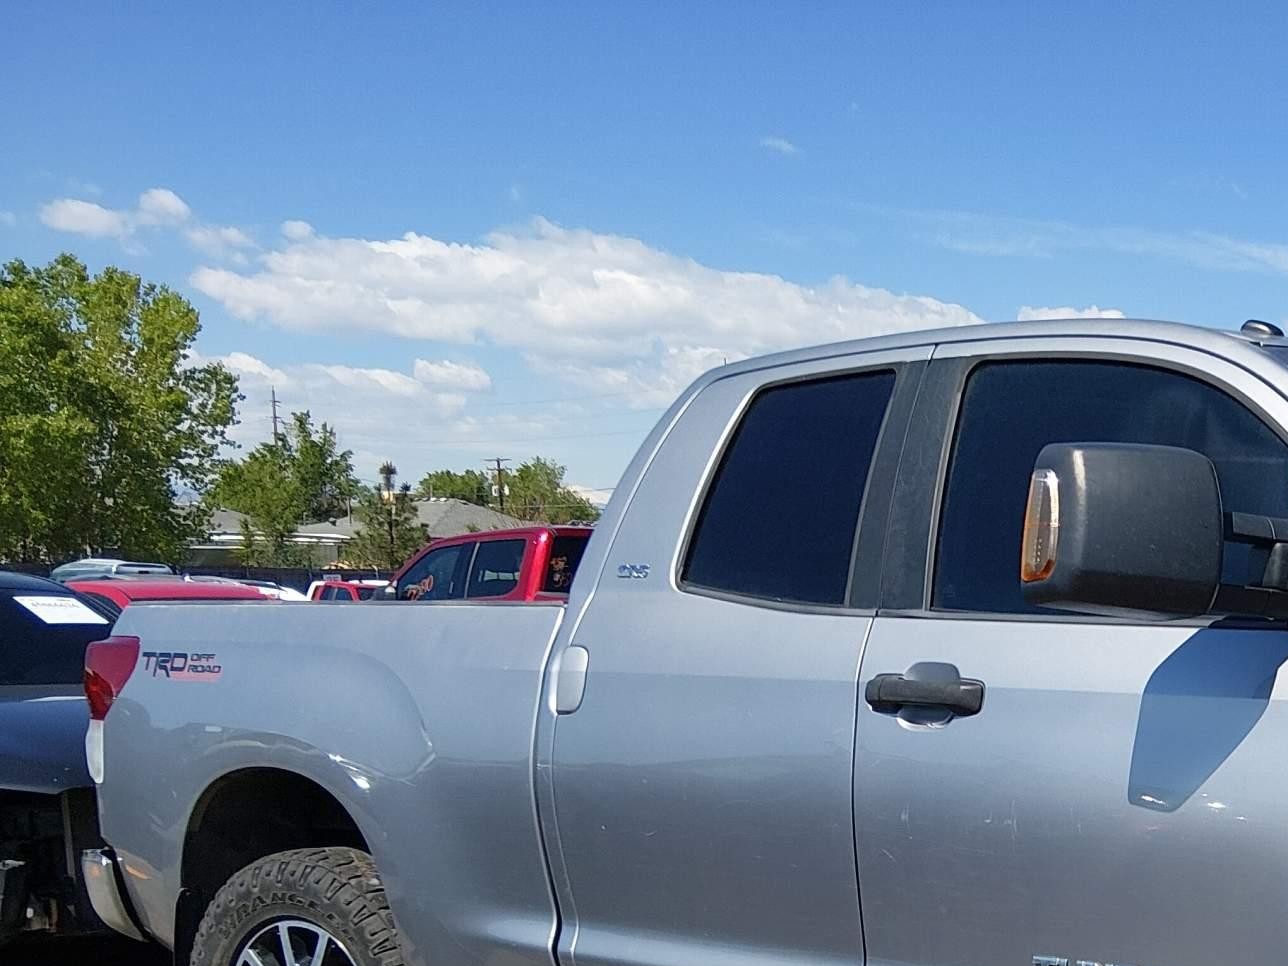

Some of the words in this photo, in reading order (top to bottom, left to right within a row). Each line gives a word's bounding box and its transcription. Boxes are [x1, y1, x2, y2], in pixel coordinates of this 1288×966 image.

[190, 653, 217, 662] OFF
[142, 651, 188, 678] TRD
[187, 664, 222, 674] ROAD
